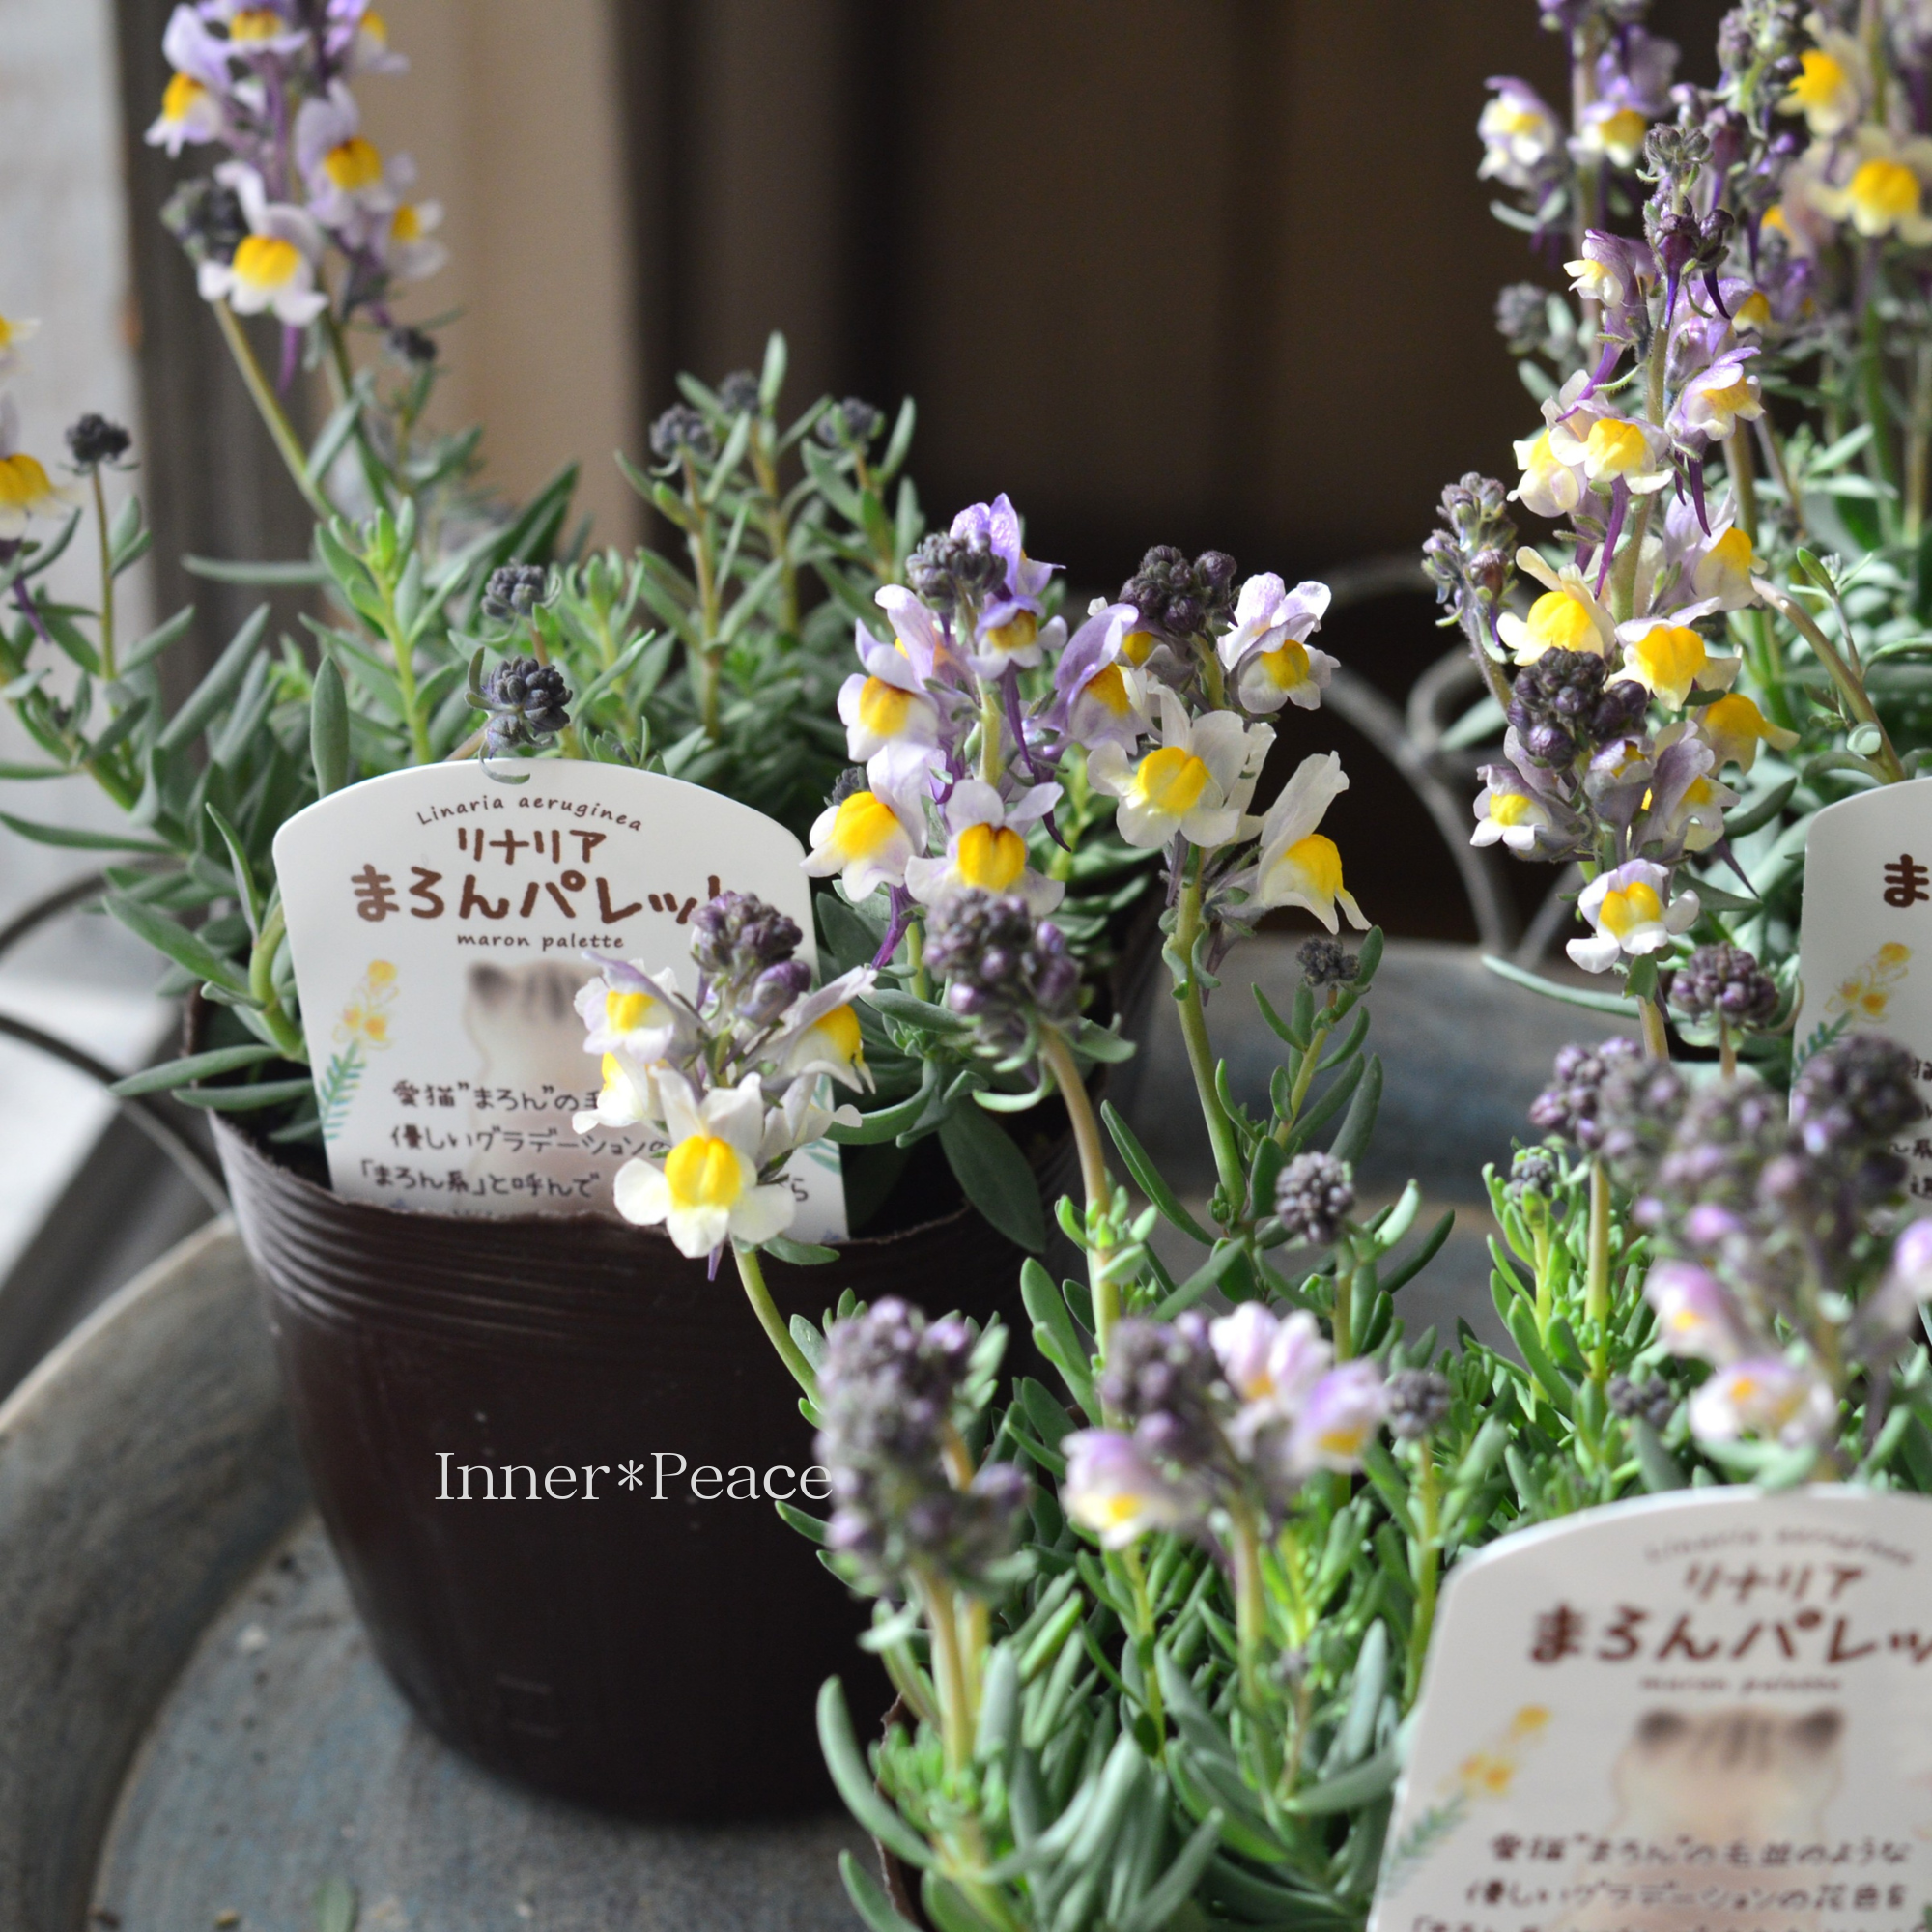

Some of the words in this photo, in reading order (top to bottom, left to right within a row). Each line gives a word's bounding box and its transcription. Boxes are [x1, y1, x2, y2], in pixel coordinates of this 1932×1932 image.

[418, 795, 504, 825] Linaria
[519, 797, 642, 831] aeruginea
[458, 827, 607, 865] リナリア
[351, 864, 721, 923] まろんパレッ
[457, 932, 531, 949] maron
[541, 932, 624, 951] palette
[1684, 1559, 1866, 1603] リナリア
